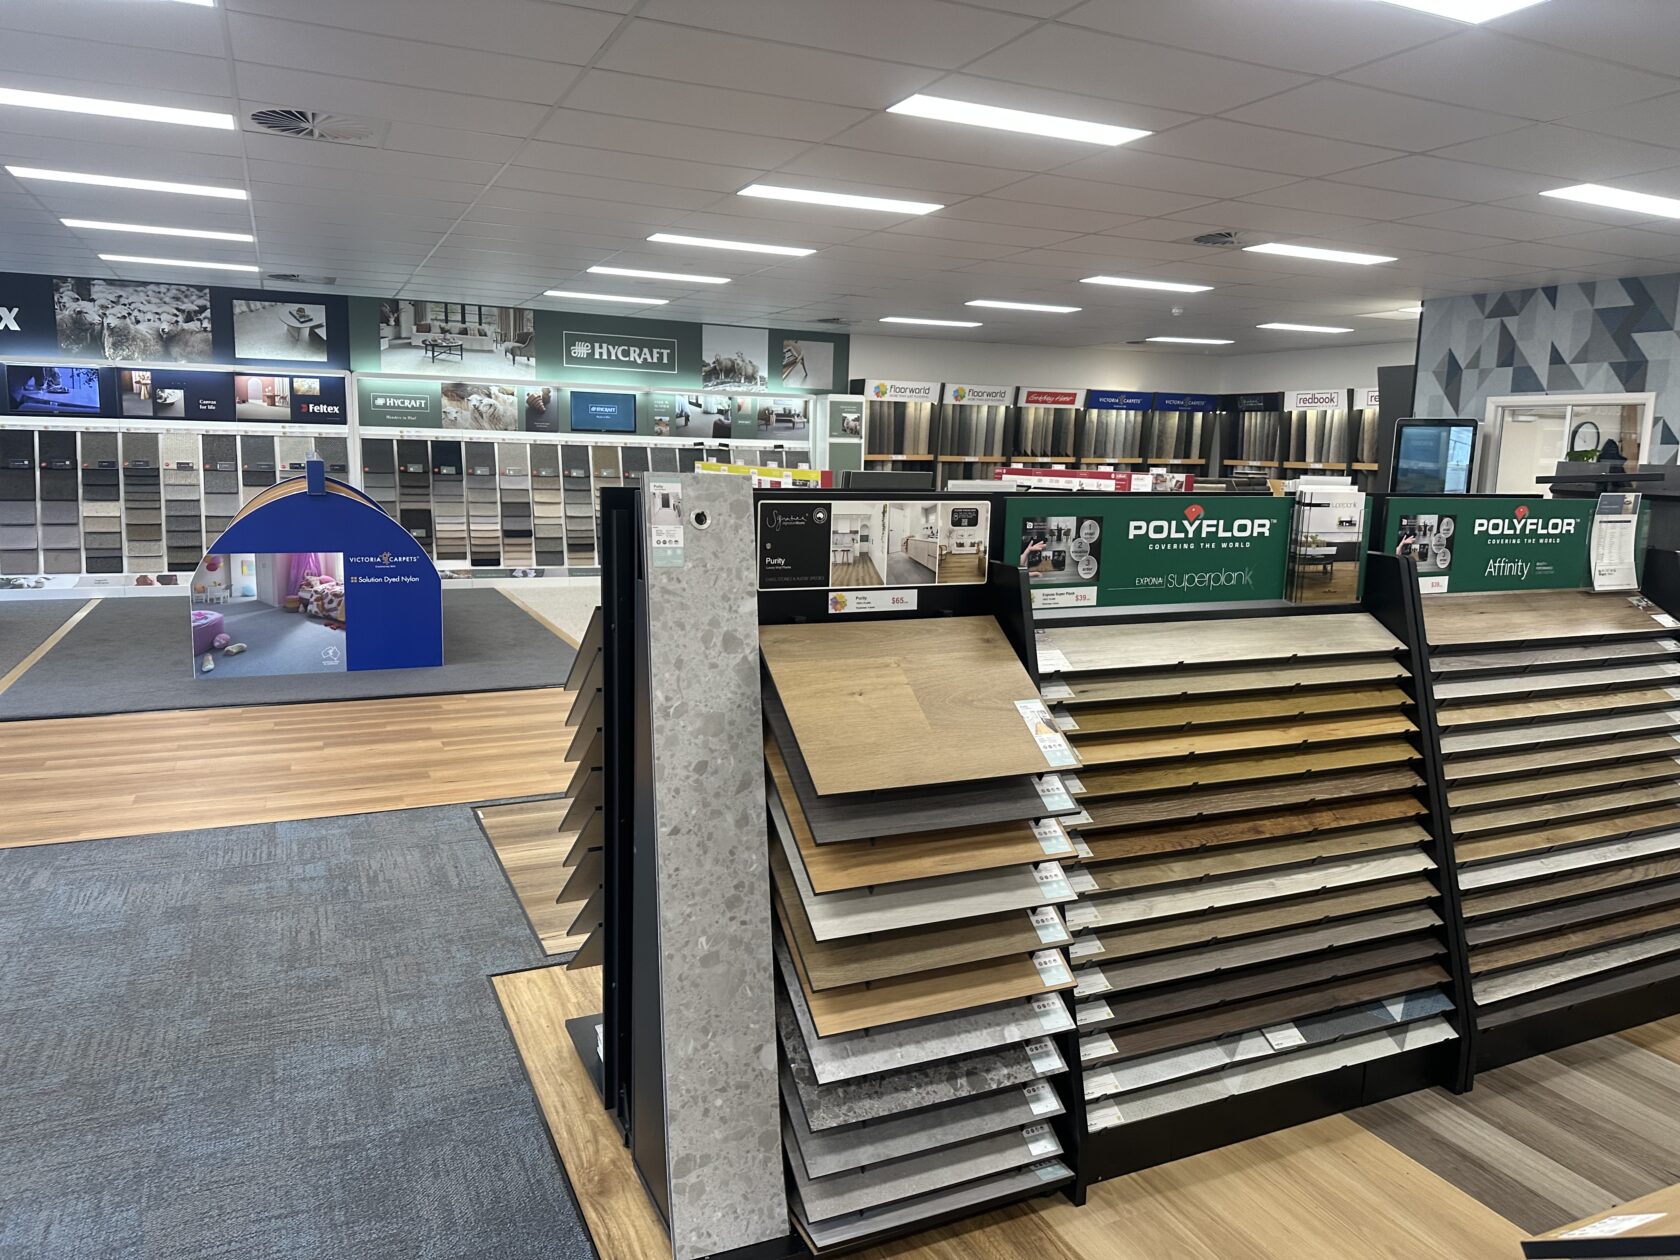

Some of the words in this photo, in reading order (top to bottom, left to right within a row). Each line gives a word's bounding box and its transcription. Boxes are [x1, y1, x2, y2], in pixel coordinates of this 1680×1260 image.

[593, 342, 671, 364] HYCRAFT
[889, 384, 930, 395] floorworld
[967, 388, 1007, 399] floorworld
[386, 397, 426, 408] HYCRAFT
[1298, 392, 1335, 405] redbook
[308, 403, 340, 413] Feltex
[1128, 518, 1270, 540] POLYFLOR
[1473, 518, 1576, 535] POLYFLOR
[1148, 542, 1195, 550] COVERING
[1221, 541, 1251, 549] WORLD
[765, 557, 786, 566] Purity
[1484, 557, 1531, 580] Affinity
[384, 575, 400, 584] Dyed
[401, 575, 420, 583] Nylon
[1167, 566, 1254, 592] superplank
[891, 596, 904, 604] $65
[1075, 594, 1087, 602] $39
